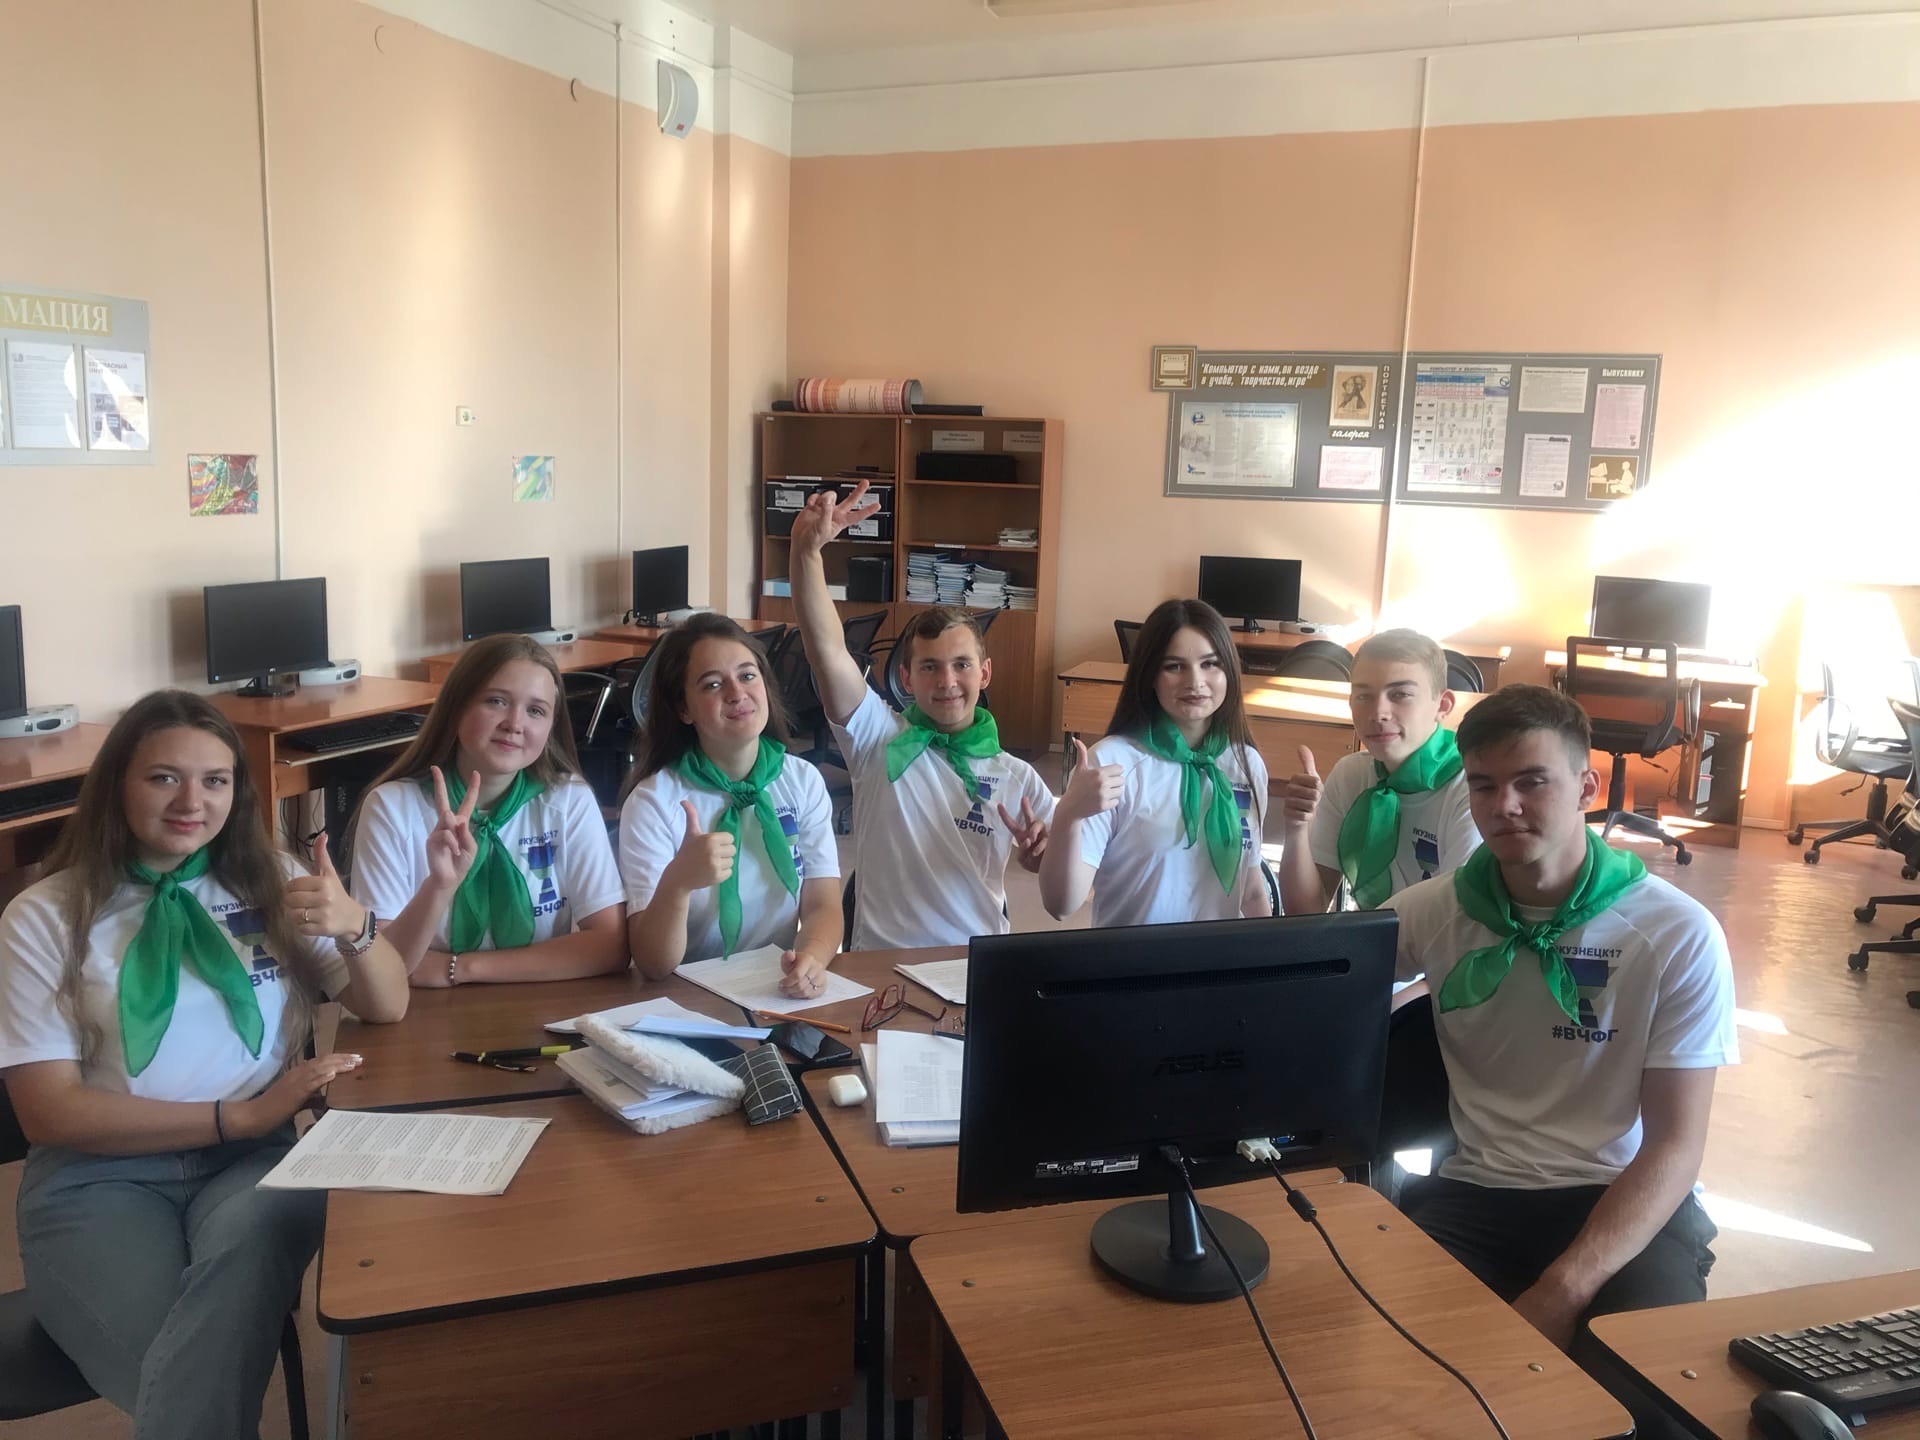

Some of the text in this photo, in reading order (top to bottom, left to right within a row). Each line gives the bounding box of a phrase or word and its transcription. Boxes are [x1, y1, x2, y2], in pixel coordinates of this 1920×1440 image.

[2, 296, 108, 335] МАЦИЯ
[1250, 365, 1256, 374] с
[1378, 365, 1390, 430] ПОРТРЕТНАЯ
[1552, 1025, 1619, 1043] #ВЧФГ
